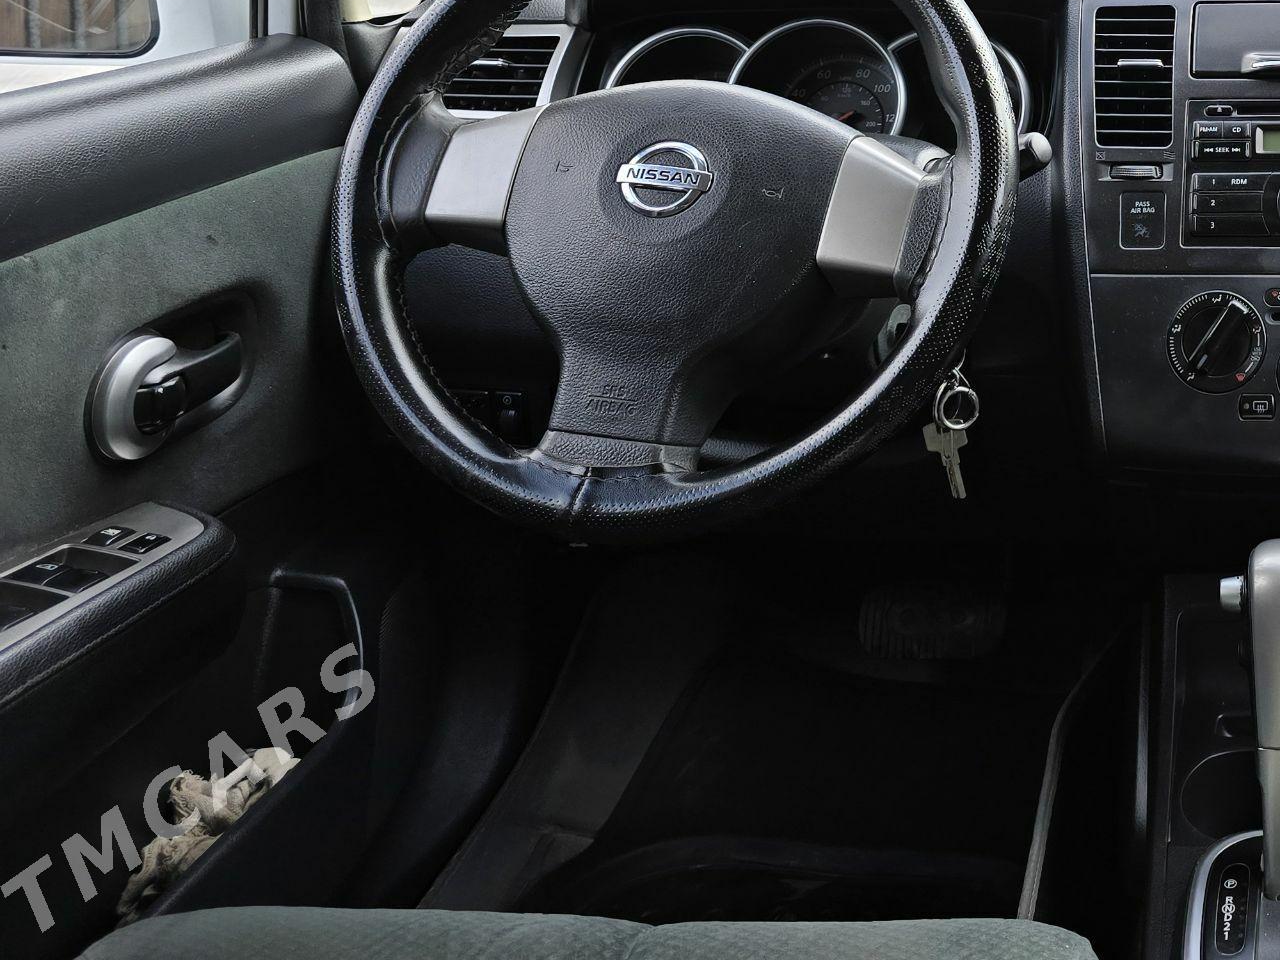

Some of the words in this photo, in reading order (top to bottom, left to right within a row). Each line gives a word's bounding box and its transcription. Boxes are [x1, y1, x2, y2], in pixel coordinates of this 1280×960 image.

[817, 69, 832, 80] 60
[855, 68, 871, 79] 80
[873, 84, 891, 93] 100
[626, 167, 702, 185] NISSAN
[1210, 221, 1215, 229] 3
[602, 384, 627, 399] SRS
[585, 398, 638, 417] AIRBAG
[1225, 896, 1234, 904] R
[1223, 914, 1232, 922] D
[1223, 922, 1231, 931] 2
[1223, 931, 1229, 940] 1
